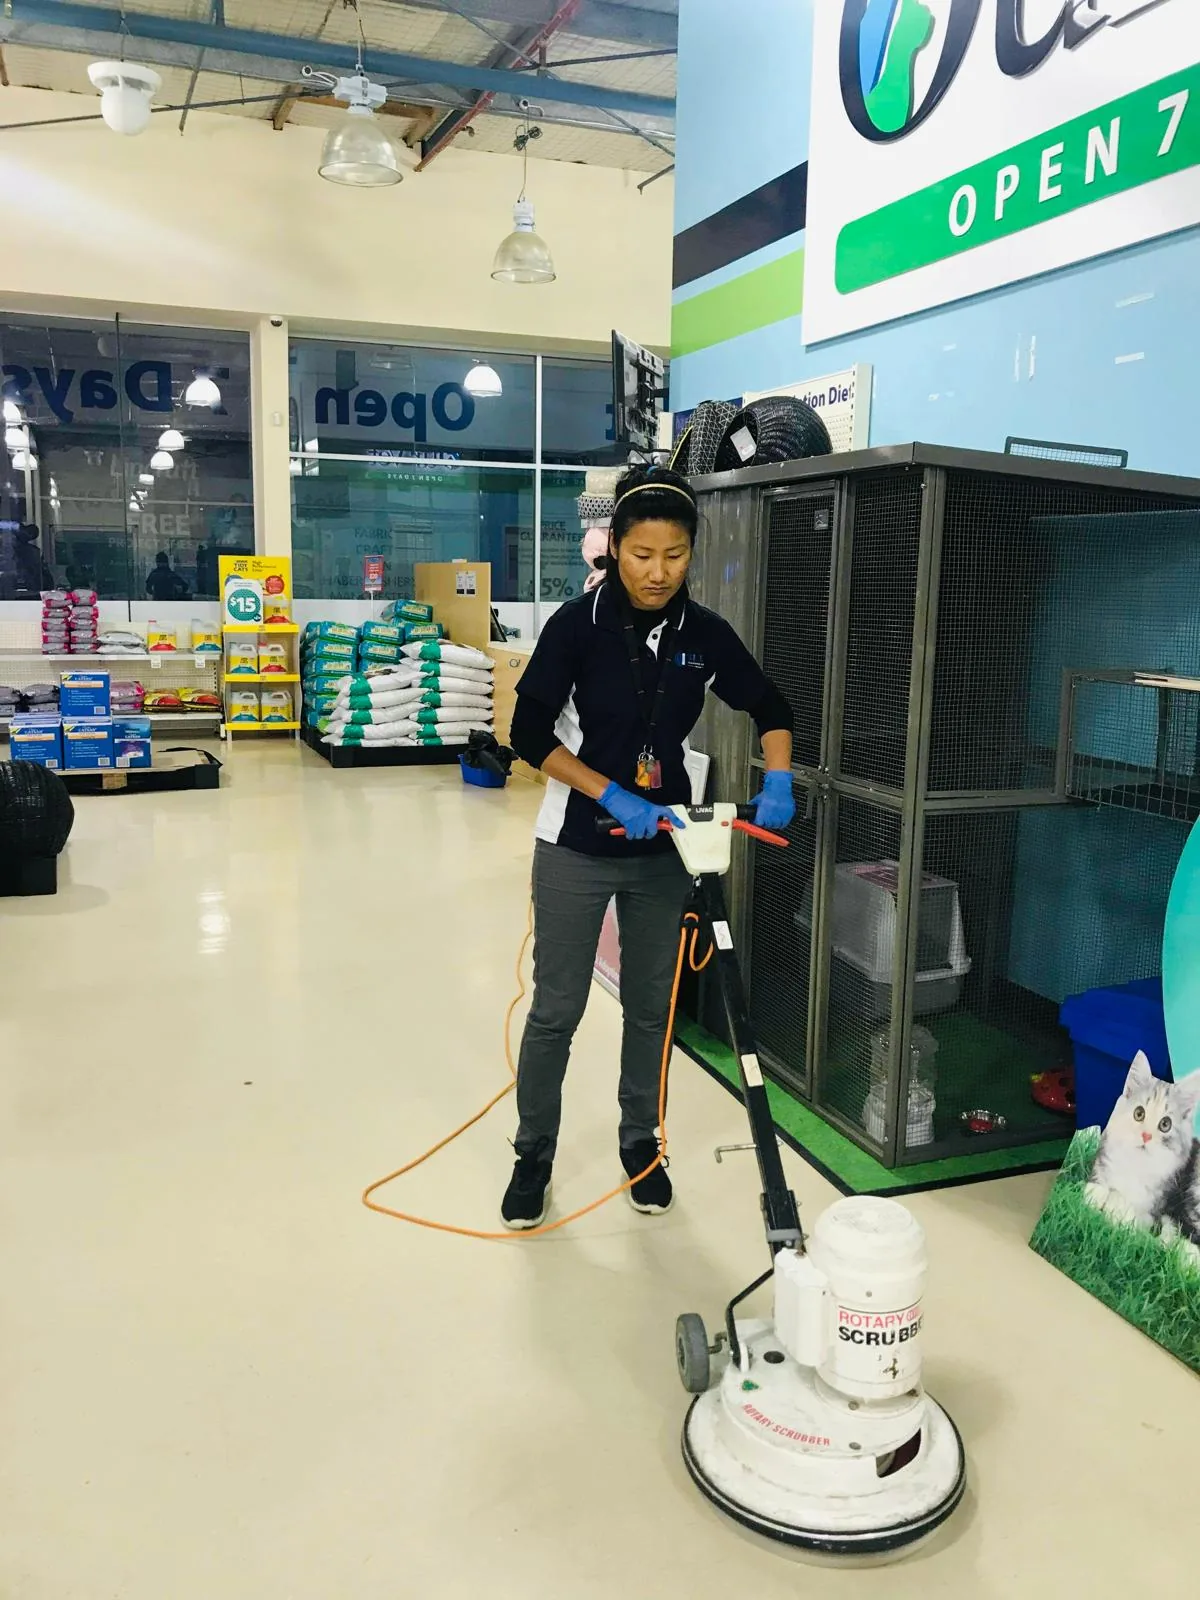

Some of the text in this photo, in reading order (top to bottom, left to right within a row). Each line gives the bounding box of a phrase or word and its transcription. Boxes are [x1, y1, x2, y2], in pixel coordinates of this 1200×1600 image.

[948, 88, 1190, 237] OPEN 7
[529, 576, 574, 597] 5%
[230, 597, 257, 613] $15
[839, 1310, 904, 1329] ROTARY
[742, 1403, 774, 1428] ROTARY
[772, 1424, 831, 1447] SCRUBBER
